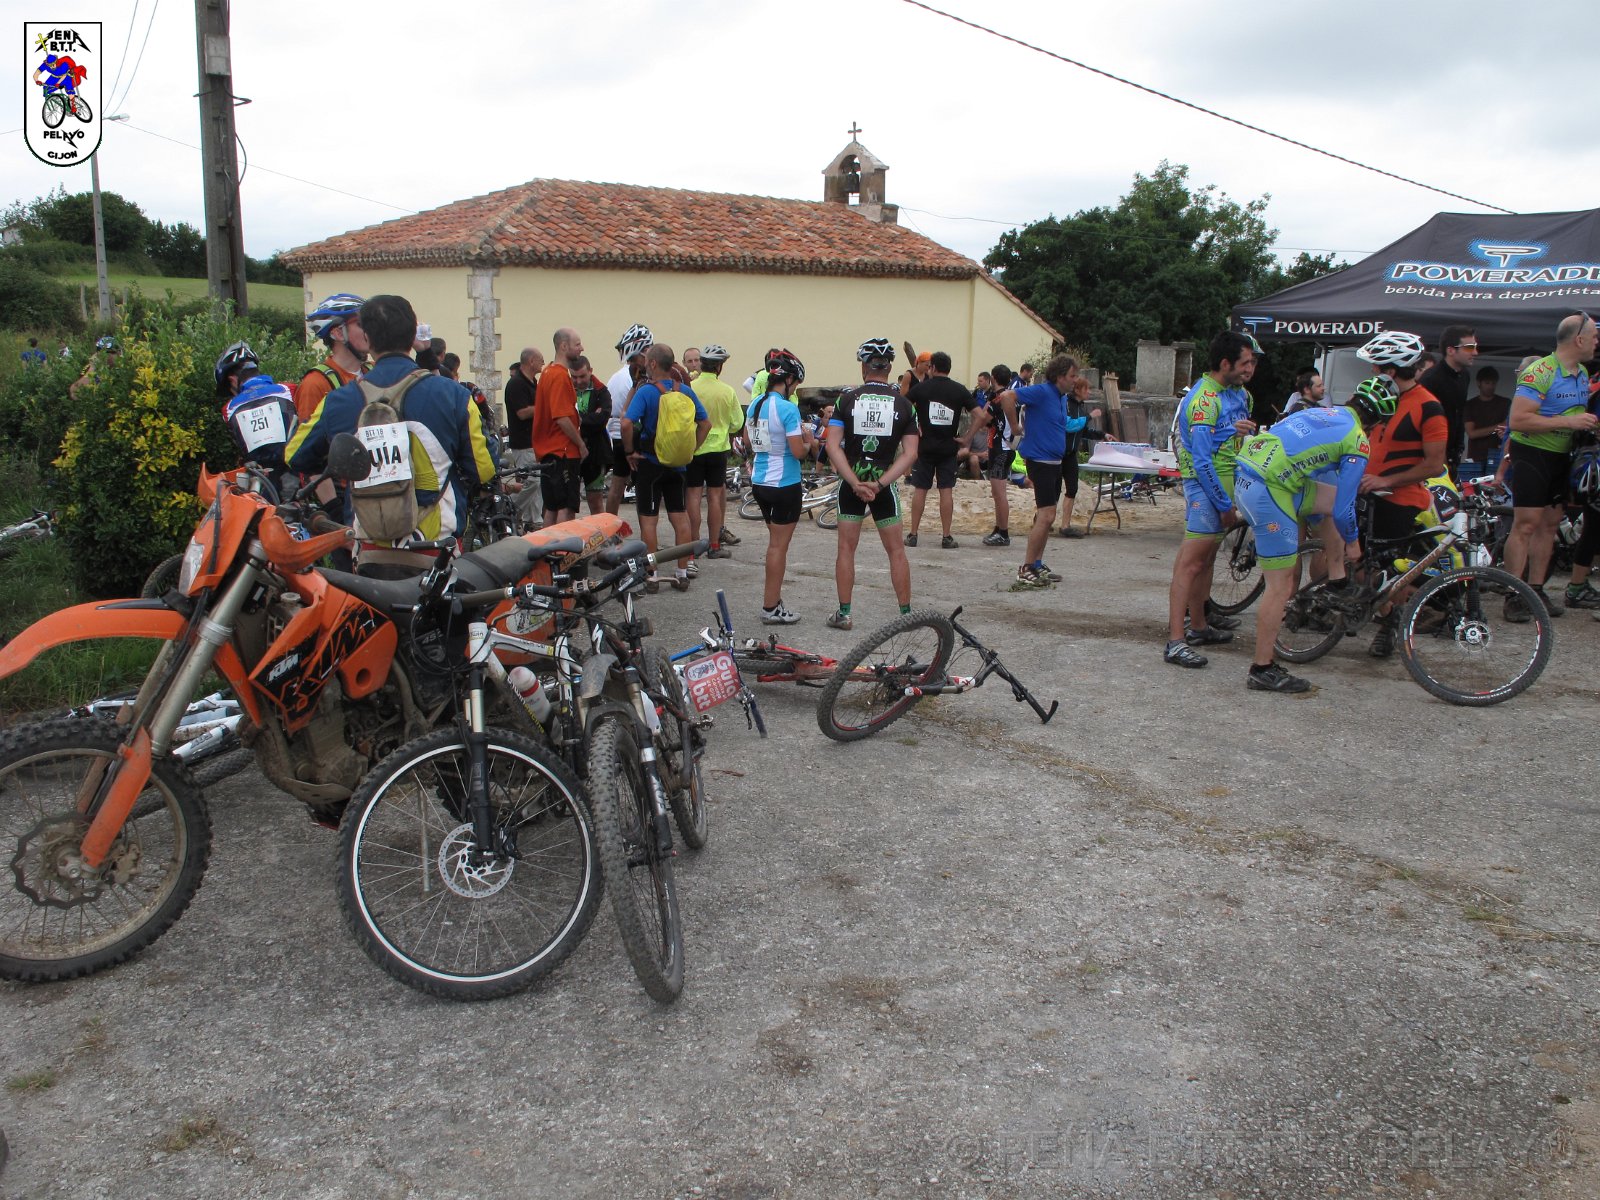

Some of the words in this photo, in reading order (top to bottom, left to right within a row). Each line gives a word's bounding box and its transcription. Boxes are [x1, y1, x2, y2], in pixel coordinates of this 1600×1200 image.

[1384, 285, 1446, 299] bebida
[1450, 290, 1494, 301] para
[1274, 321, 1385, 335] POWERADE
[250, 416, 270, 433] 251
[866, 411, 882, 422] 187
[367, 441, 402, 467] UÍA
[267, 653, 299, 682] KTM
[692, 681, 712, 709] btt
